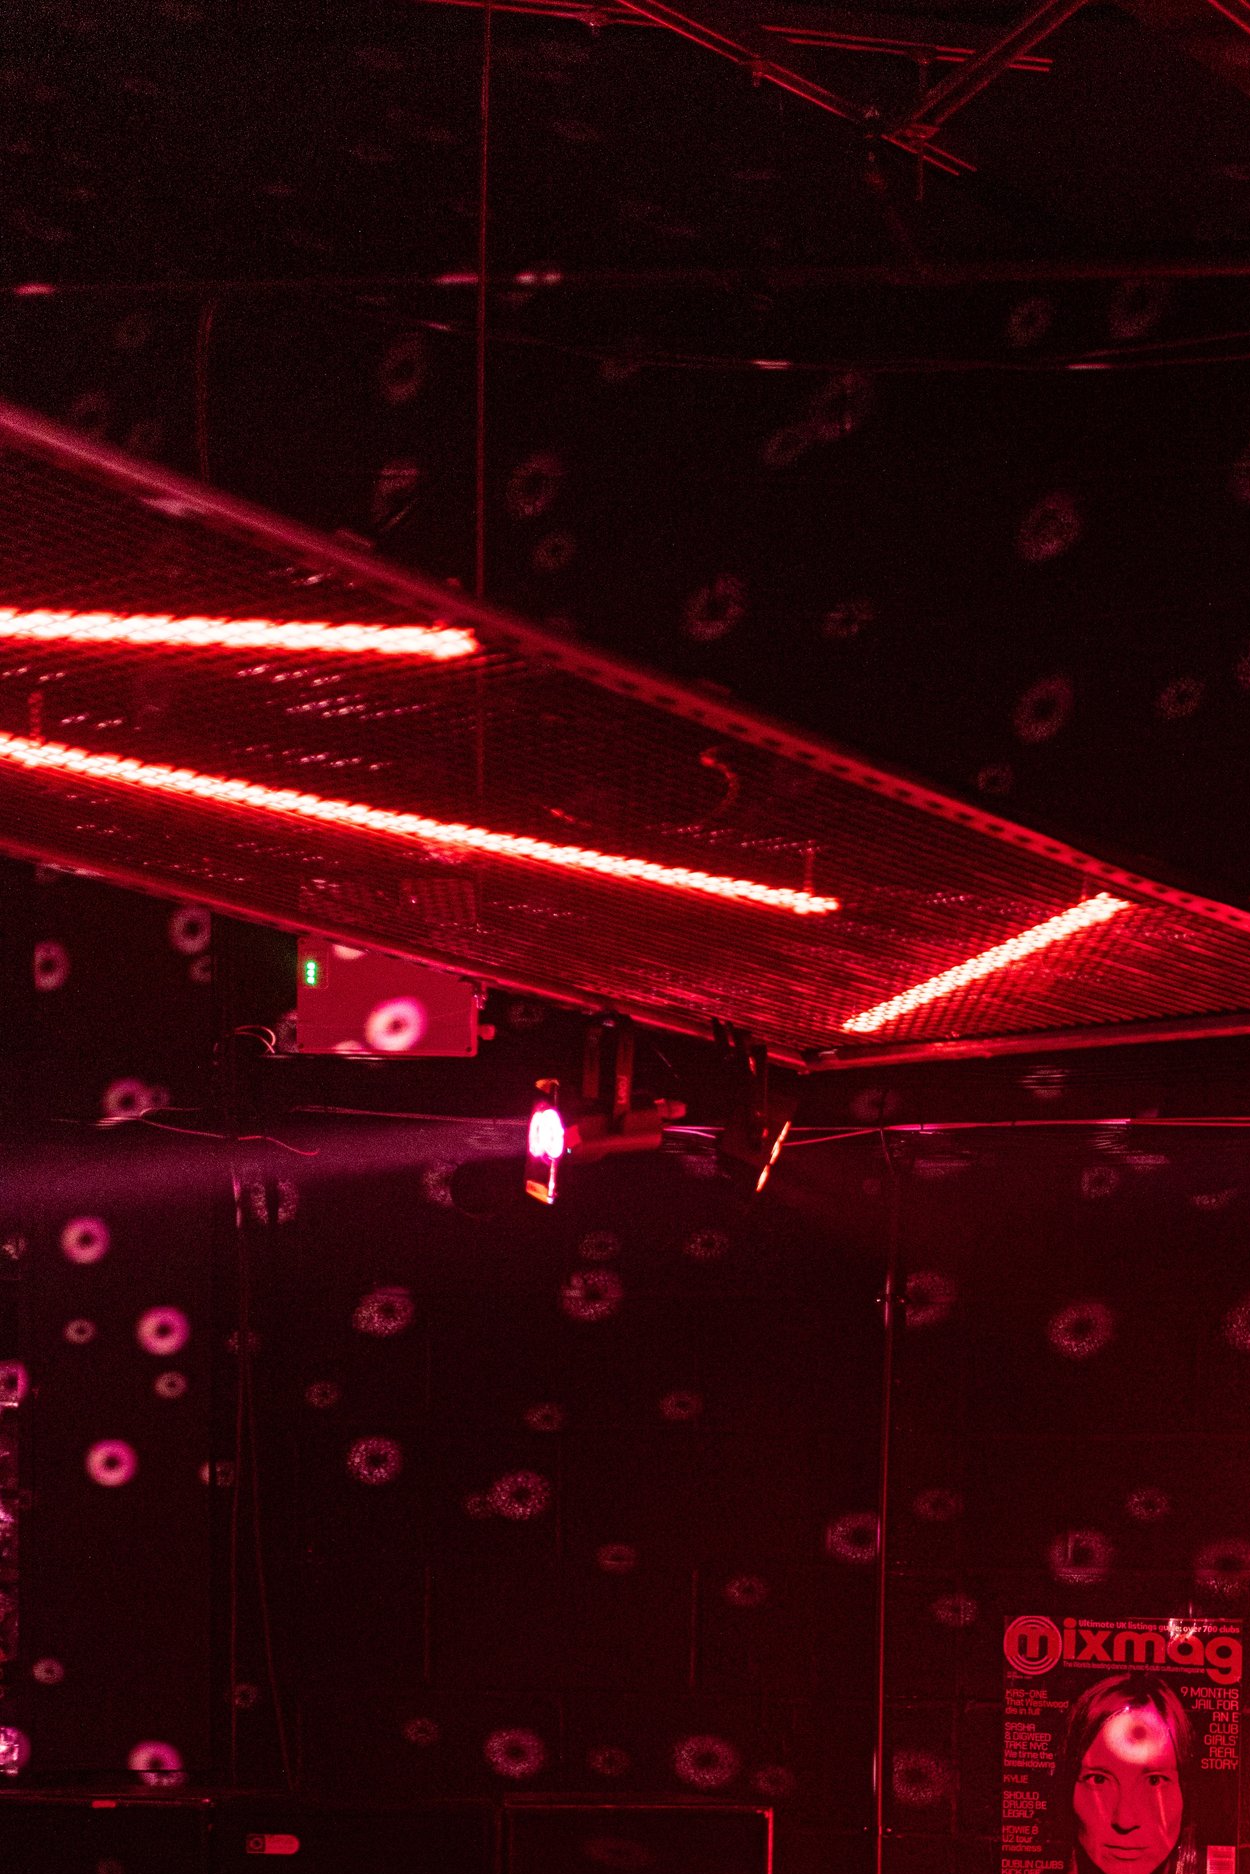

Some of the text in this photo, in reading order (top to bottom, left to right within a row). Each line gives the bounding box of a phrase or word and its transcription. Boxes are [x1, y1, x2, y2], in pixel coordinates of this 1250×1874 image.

[1079, 1619, 1115, 1628] Ultimate
[1116, 1621, 1127, 1629] UK
[1128, 1621, 1157, 1632] listings
[1219, 1625, 1240, 1633] clubs
[1005, 1688, 1048, 1699] KRS-ONE
[1180, 1686, 1239, 1699] 9 MONTHS
[1005, 1698, 1069, 1708] That Westwood
[1191, 1699, 1239, 1711] JAIL FOR
[1213, 1712, 1239, 1723] AN E
[1005, 1722, 1036, 1732] SASHA
[1209, 1723, 1239, 1735] CLUB
[1013, 1732, 1052, 1742] DIGWEED
[1204, 1734, 1239, 1746] GIRLS'
[1004, 1741, 1049, 1751] TAKE NYC
[1004, 1750, 1018, 1758] We
[1040, 1751, 1054, 1760] the
[1209, 1747, 1239, 1759] REAL
[1201, 1758, 1239, 1770] STORY
[1004, 1774, 1029, 1784] KYLIE
[1003, 1790, 1040, 1800] SHOULD
[1003, 1800, 1048, 1810] DRUGS BE
[1002, 1809, 1035, 1819] LEGAL?
[1002, 1825, 1031, 1835] HOWIE
[1002, 1834, 1033, 1843] U2 tour
[1002, 1844, 1042, 1853] madness
[1002, 1859, 1064, 1870] DUBLIN CLUBS
